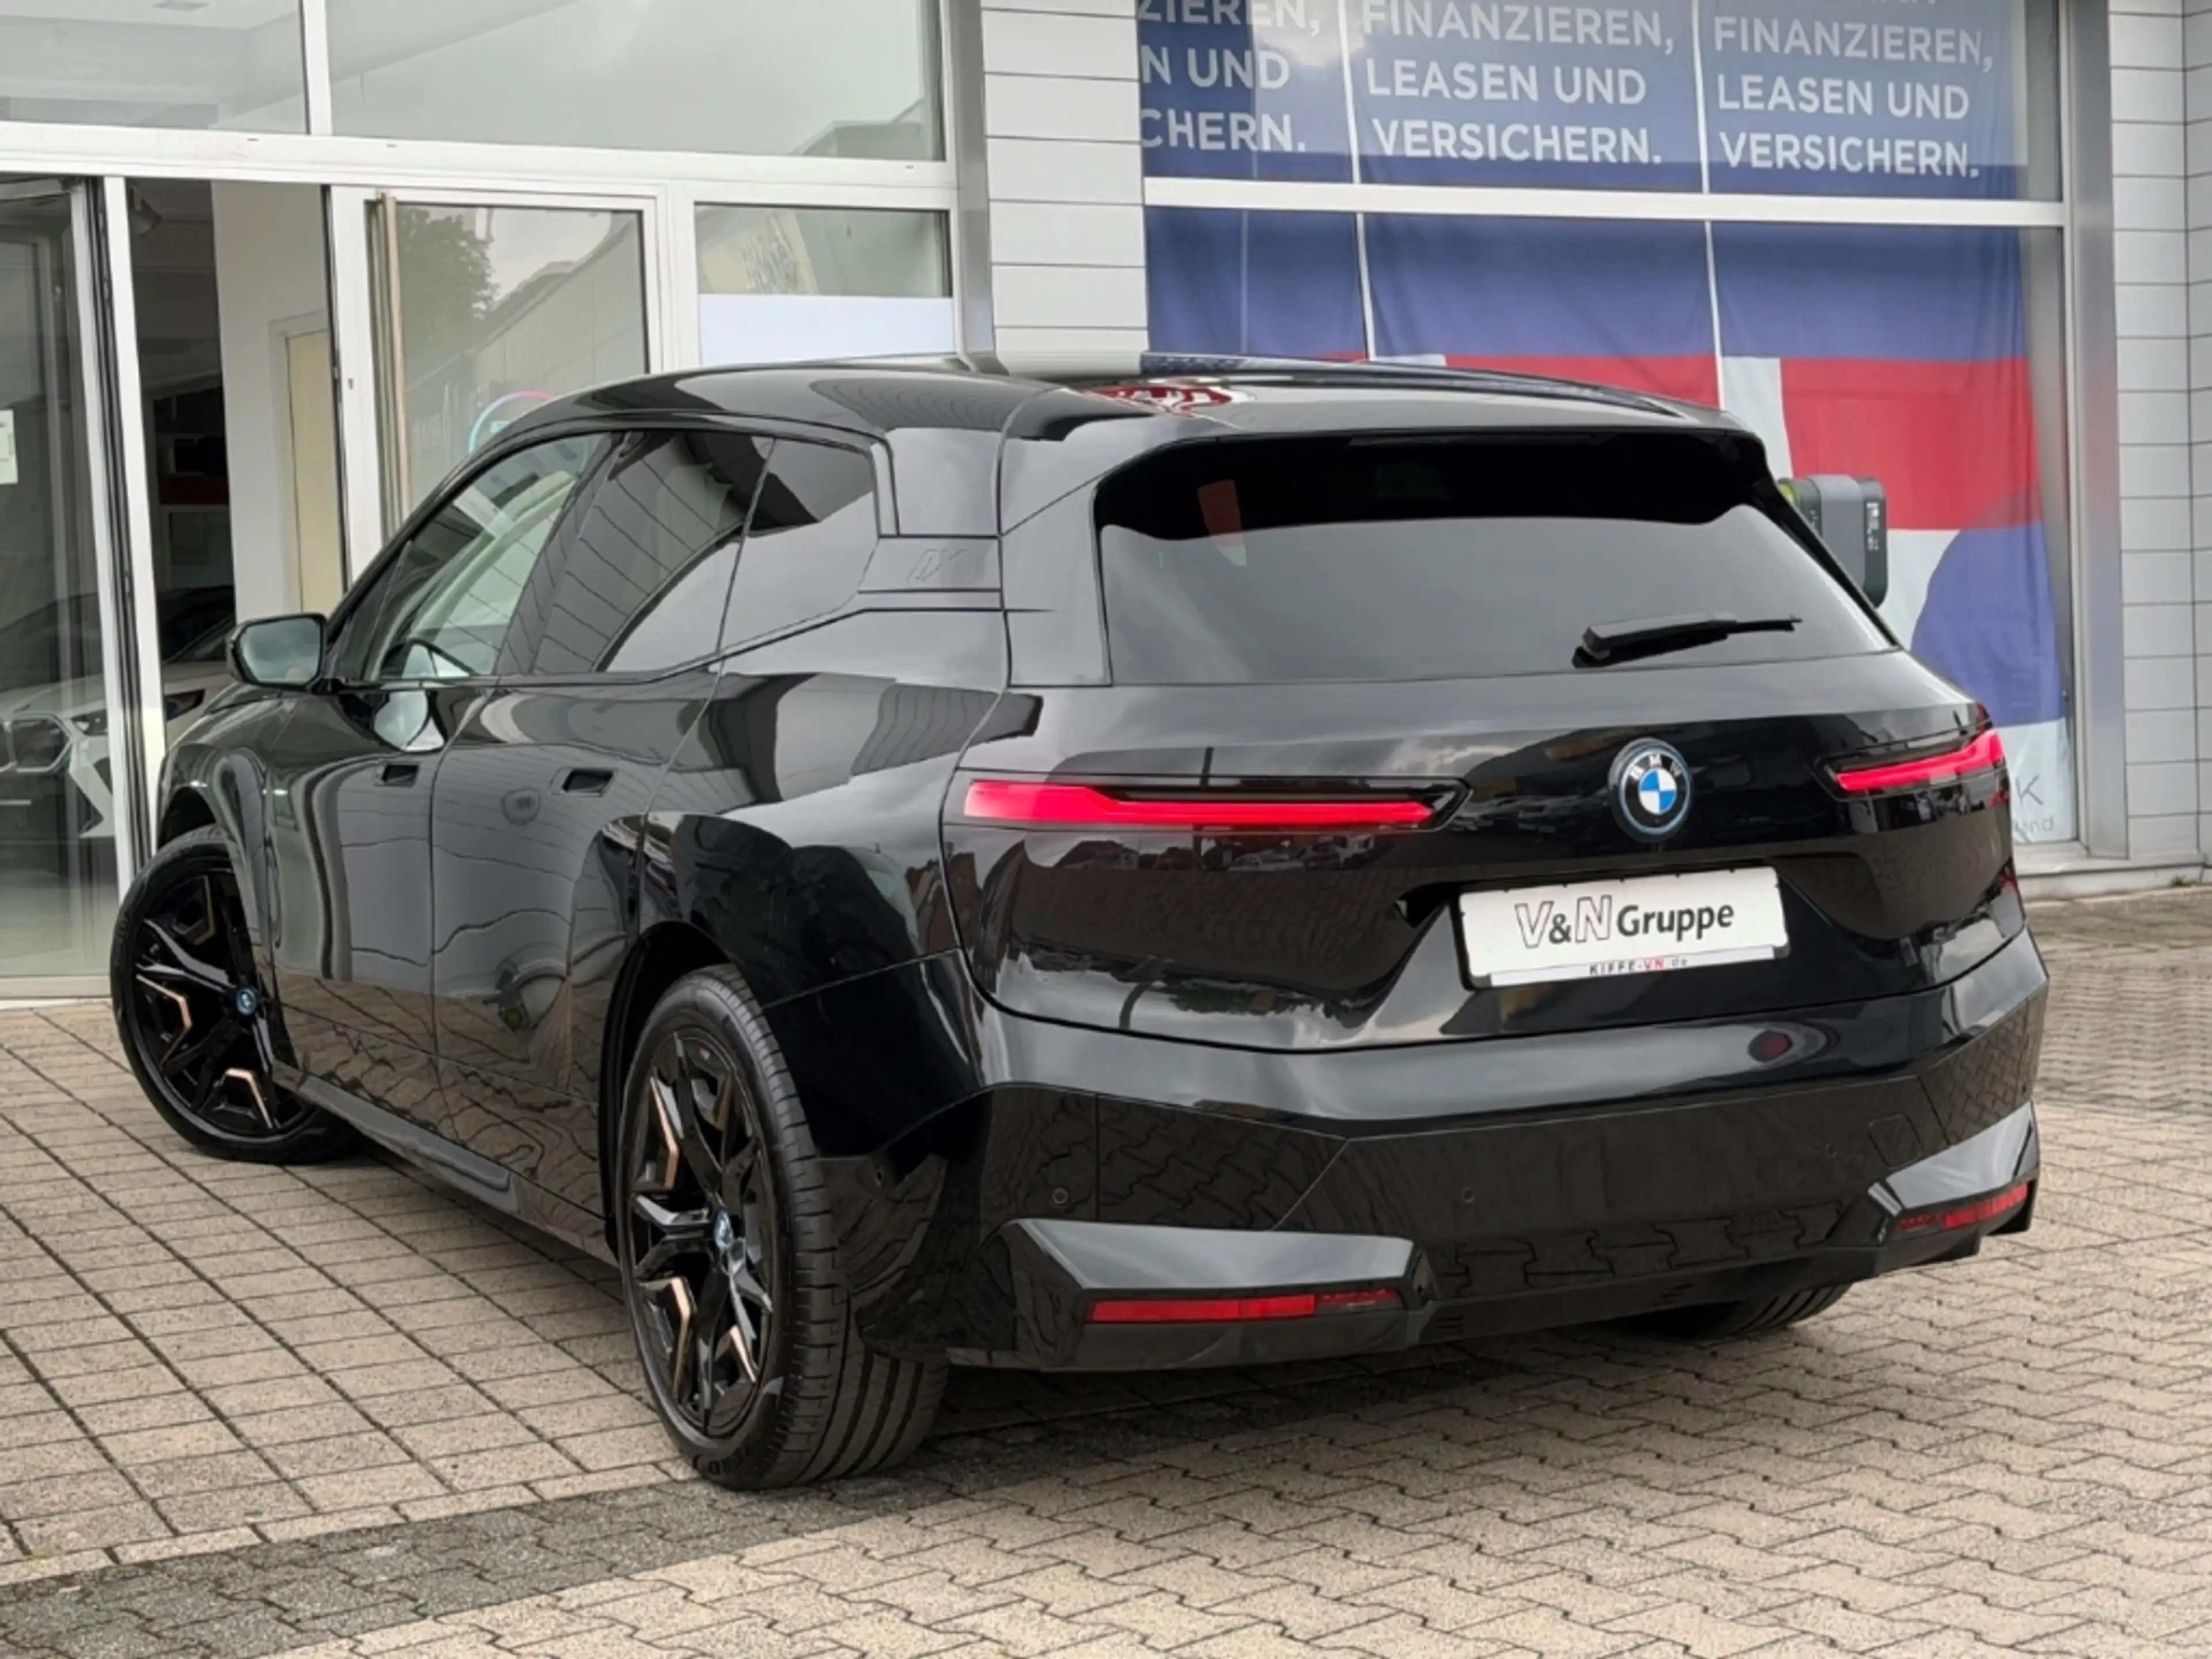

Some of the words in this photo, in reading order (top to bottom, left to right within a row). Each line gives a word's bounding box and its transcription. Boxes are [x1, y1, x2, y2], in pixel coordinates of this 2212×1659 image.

[1362, 0, 1673, 55] FINANZIEREN,
[1714, 16, 1994, 74] FINANZIEREN,
[1187, 47, 1290, 90] UND
[1366, 58, 1539, 102] LEASEN
[1554, 66, 1646, 105] UND
[1717, 75, 1873, 116] LEASEN
[1887, 82, 1969, 120] UND
[1372, 118, 1662, 164] VERSICHERN.
[1719, 132, 1980, 179] VERSICHERN.
[1616, 904, 1735, 942] Gruppe
